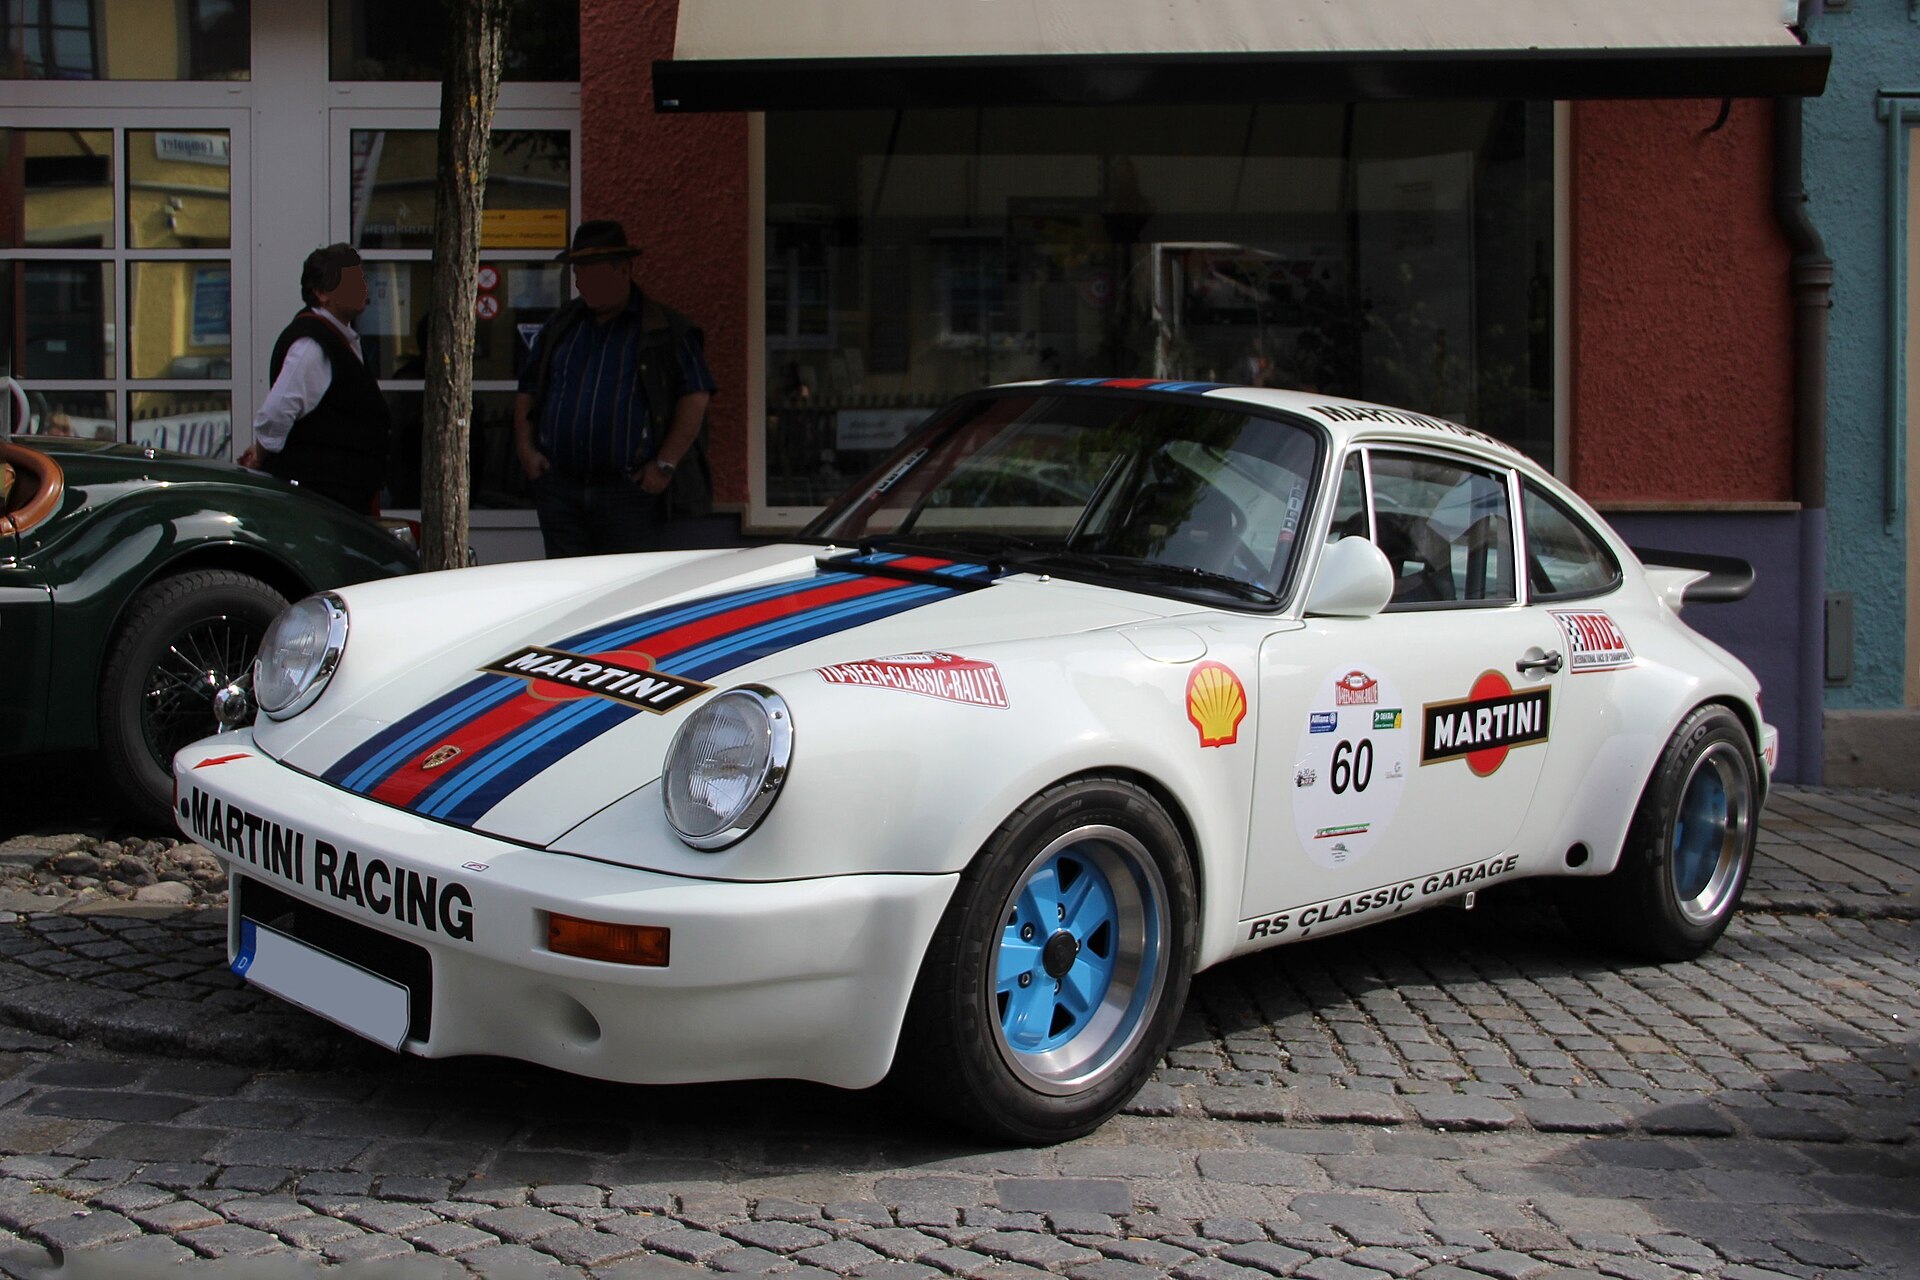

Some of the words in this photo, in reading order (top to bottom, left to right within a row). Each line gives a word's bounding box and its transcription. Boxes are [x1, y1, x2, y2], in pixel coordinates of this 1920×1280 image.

[1307, 405, 1444, 431] MARTINI
[1571, 614, 1624, 651] IROC
[504, 652, 685, 703] MARTINI
[1433, 699, 1541, 750] MARTINI
[1331, 738, 1373, 794] 60
[192, 786, 304, 885] MARTINI
[315, 839, 474, 942] RACING
[1248, 914, 1290, 941] RS
[1298, 882, 1415, 929] CLASSIC
[1421, 854, 1519, 895] GARAGE
[237, 955, 248, 969] D
